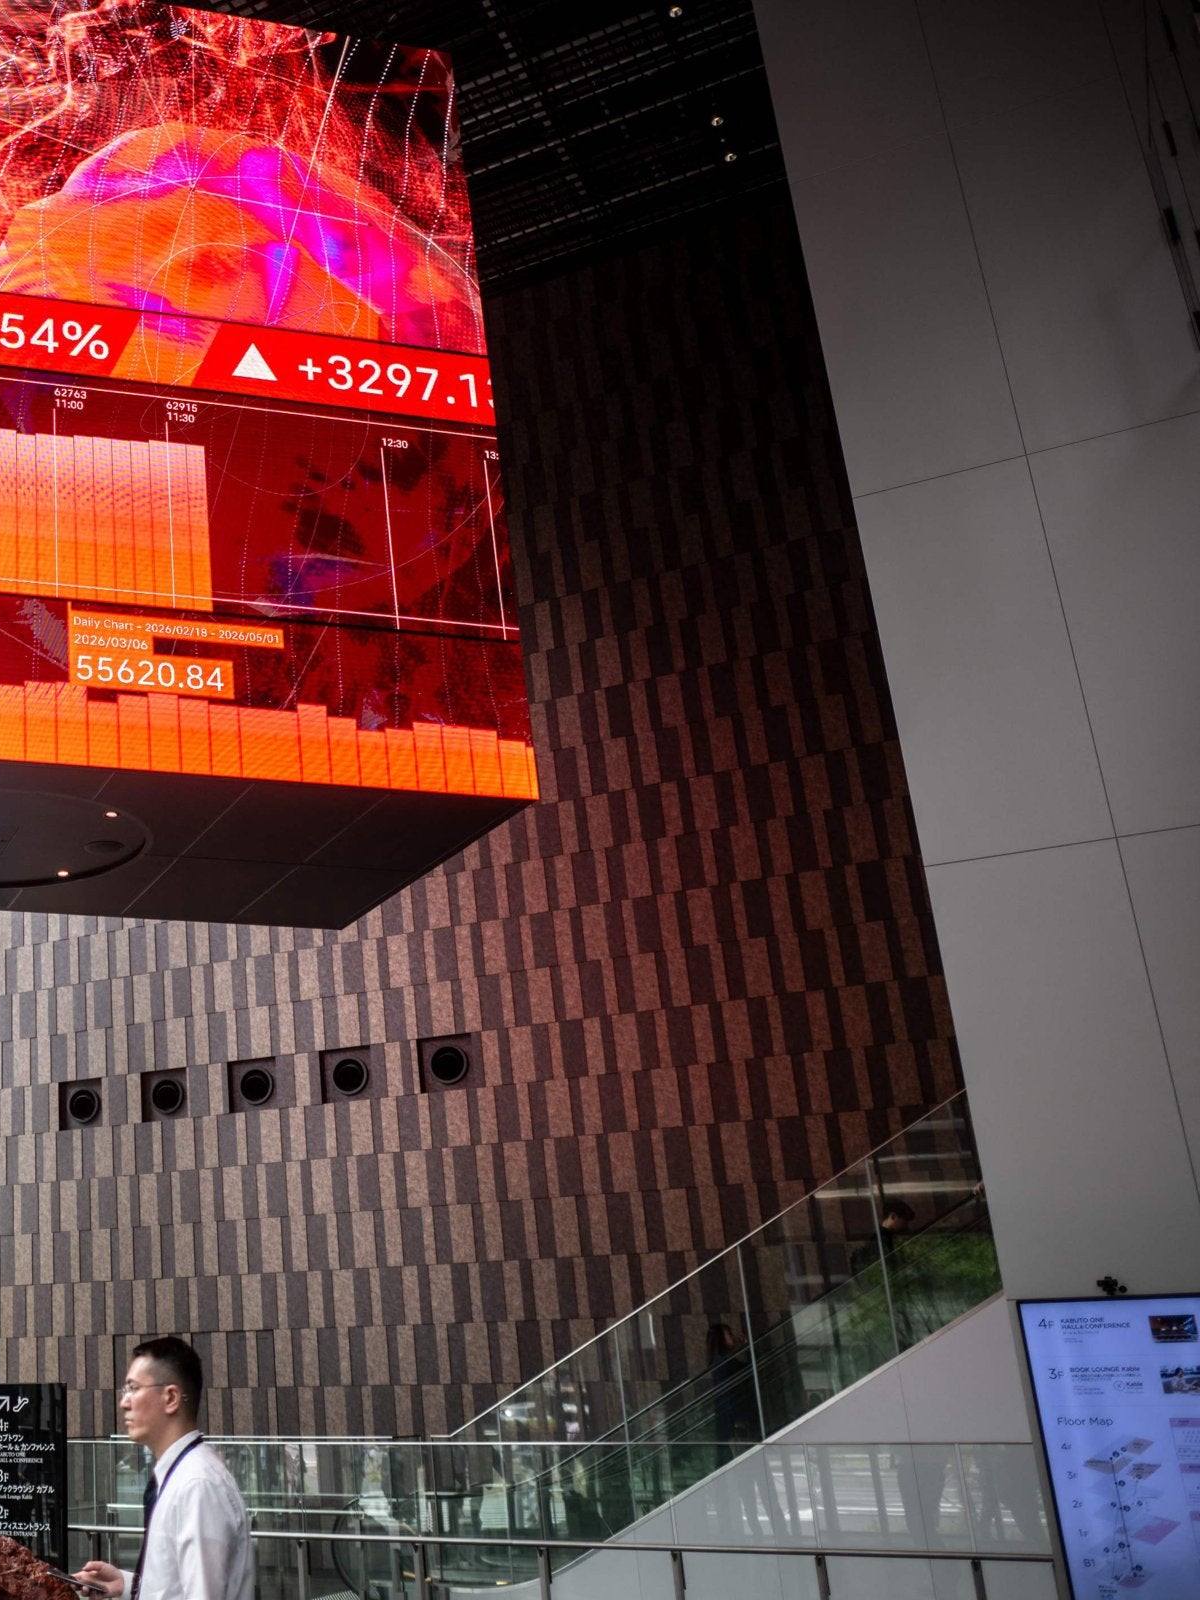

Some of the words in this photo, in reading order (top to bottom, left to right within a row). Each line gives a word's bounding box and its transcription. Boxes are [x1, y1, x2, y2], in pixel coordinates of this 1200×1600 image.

[298, 355, 496, 409] +3297.1
[53, 388, 87, 400] 62763
[55, 399, 84, 411] 11:00
[166, 401, 198, 413] 62915
[167, 412, 195, 423] 11:30
[382, 437, 408, 449] 12:30
[73, 616, 100, 629] Daily
[103, 619, 134, 631] Chart
[145, 623, 208, 638] 2026/02/18
[218, 629, 280, 644] 2026/05/01
[74, 634, 149, 650] 2026/03/06
[76, 655, 225, 691] 55620.84
[1038, 1318, 1054, 1329] 4F
[1048, 1368, 1064, 1380] 3F
[1057, 1417, 1086, 1426] Floor
[1089, 1417, 1114, 1427] Map
